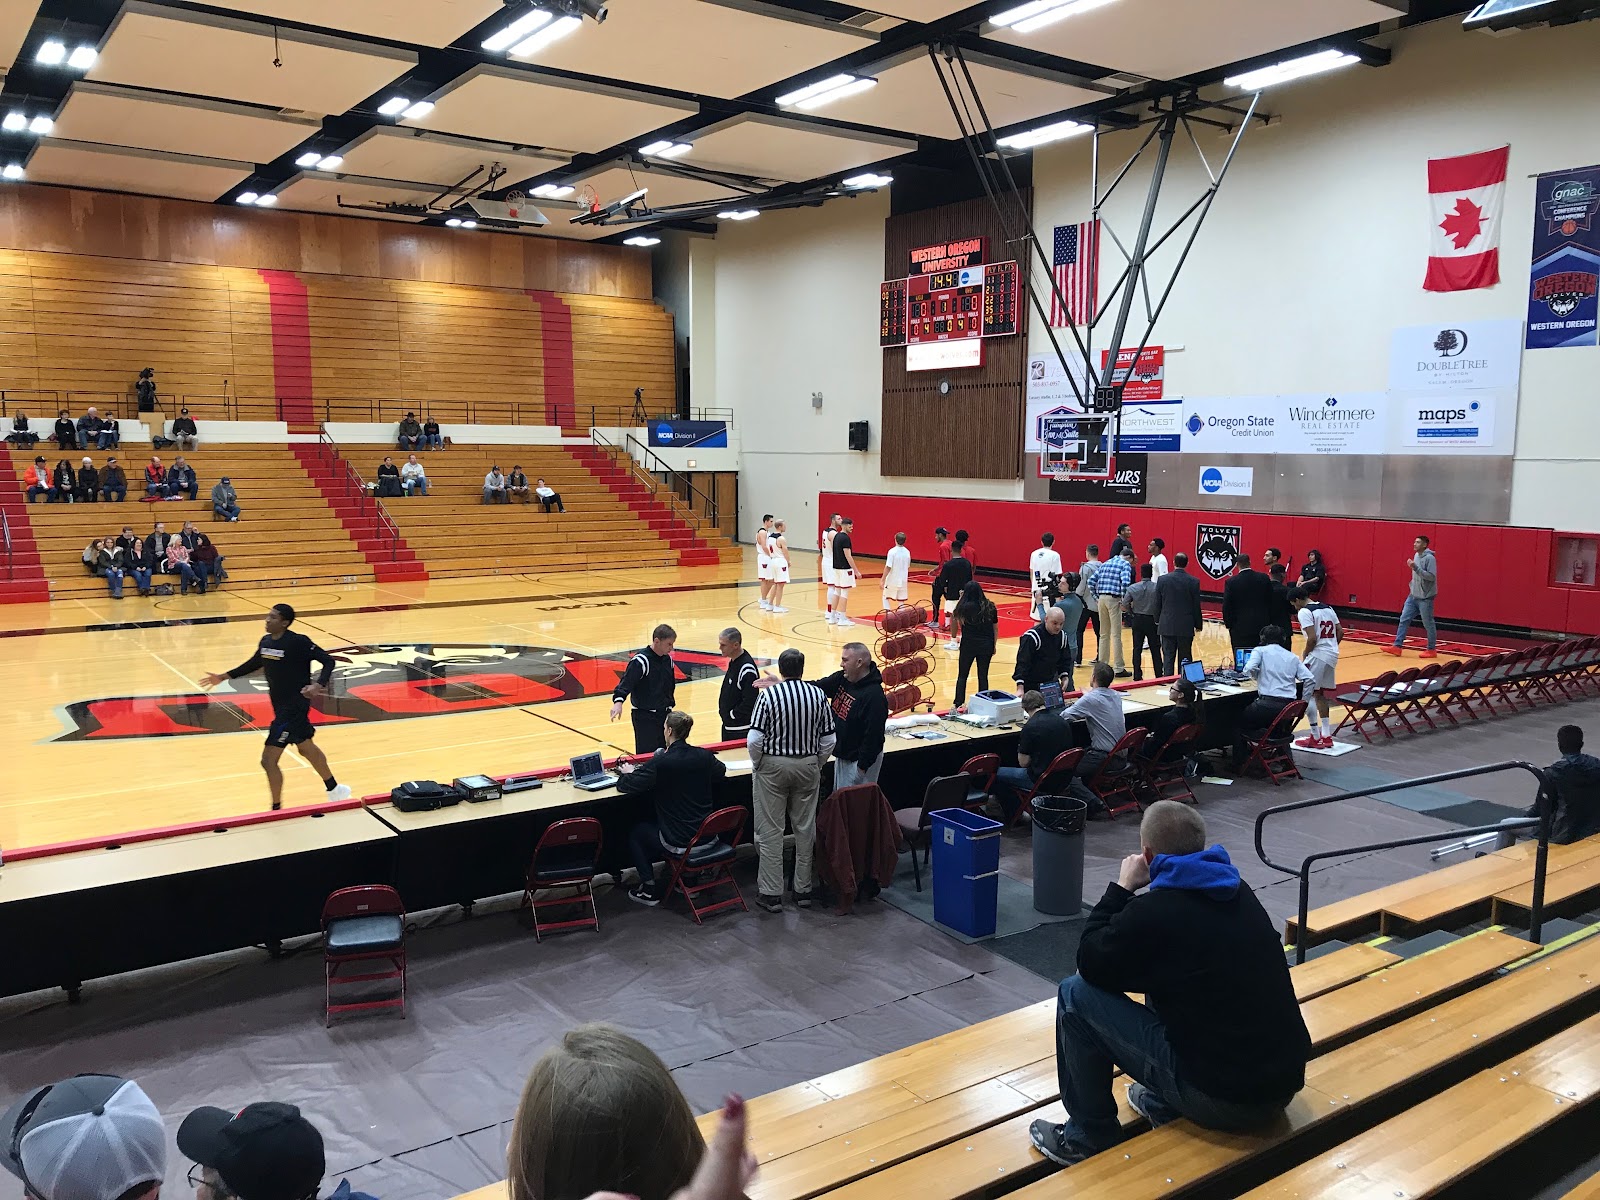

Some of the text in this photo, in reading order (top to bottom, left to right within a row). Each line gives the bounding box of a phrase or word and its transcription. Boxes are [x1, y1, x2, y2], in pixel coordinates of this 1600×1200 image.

[1555, 187, 1585, 201] gnac
[1553, 205, 1588, 215] CONFERENCE
[1554, 212, 1586, 221] CHAMPIONS
[911, 239, 981, 263] WESTERN OREGON
[921, 254, 969, 273] UNIVERSITY
[1533, 280, 1596, 300] OREGON
[1530, 319, 1595, 331] WESTERN OREGON
[1289, 406, 1376, 421] Windermere
[1418, 410, 1466, 424] maps
[1208, 415, 1275, 430] Oregon State
[1231, 428, 1274, 437] Credit Union
[1203, 478, 1223, 488] NCAA
[1224, 479, 1244, 488] Division
[1201, 527, 1237, 535] WOLVES
[1320, 620, 1334, 638] 22
